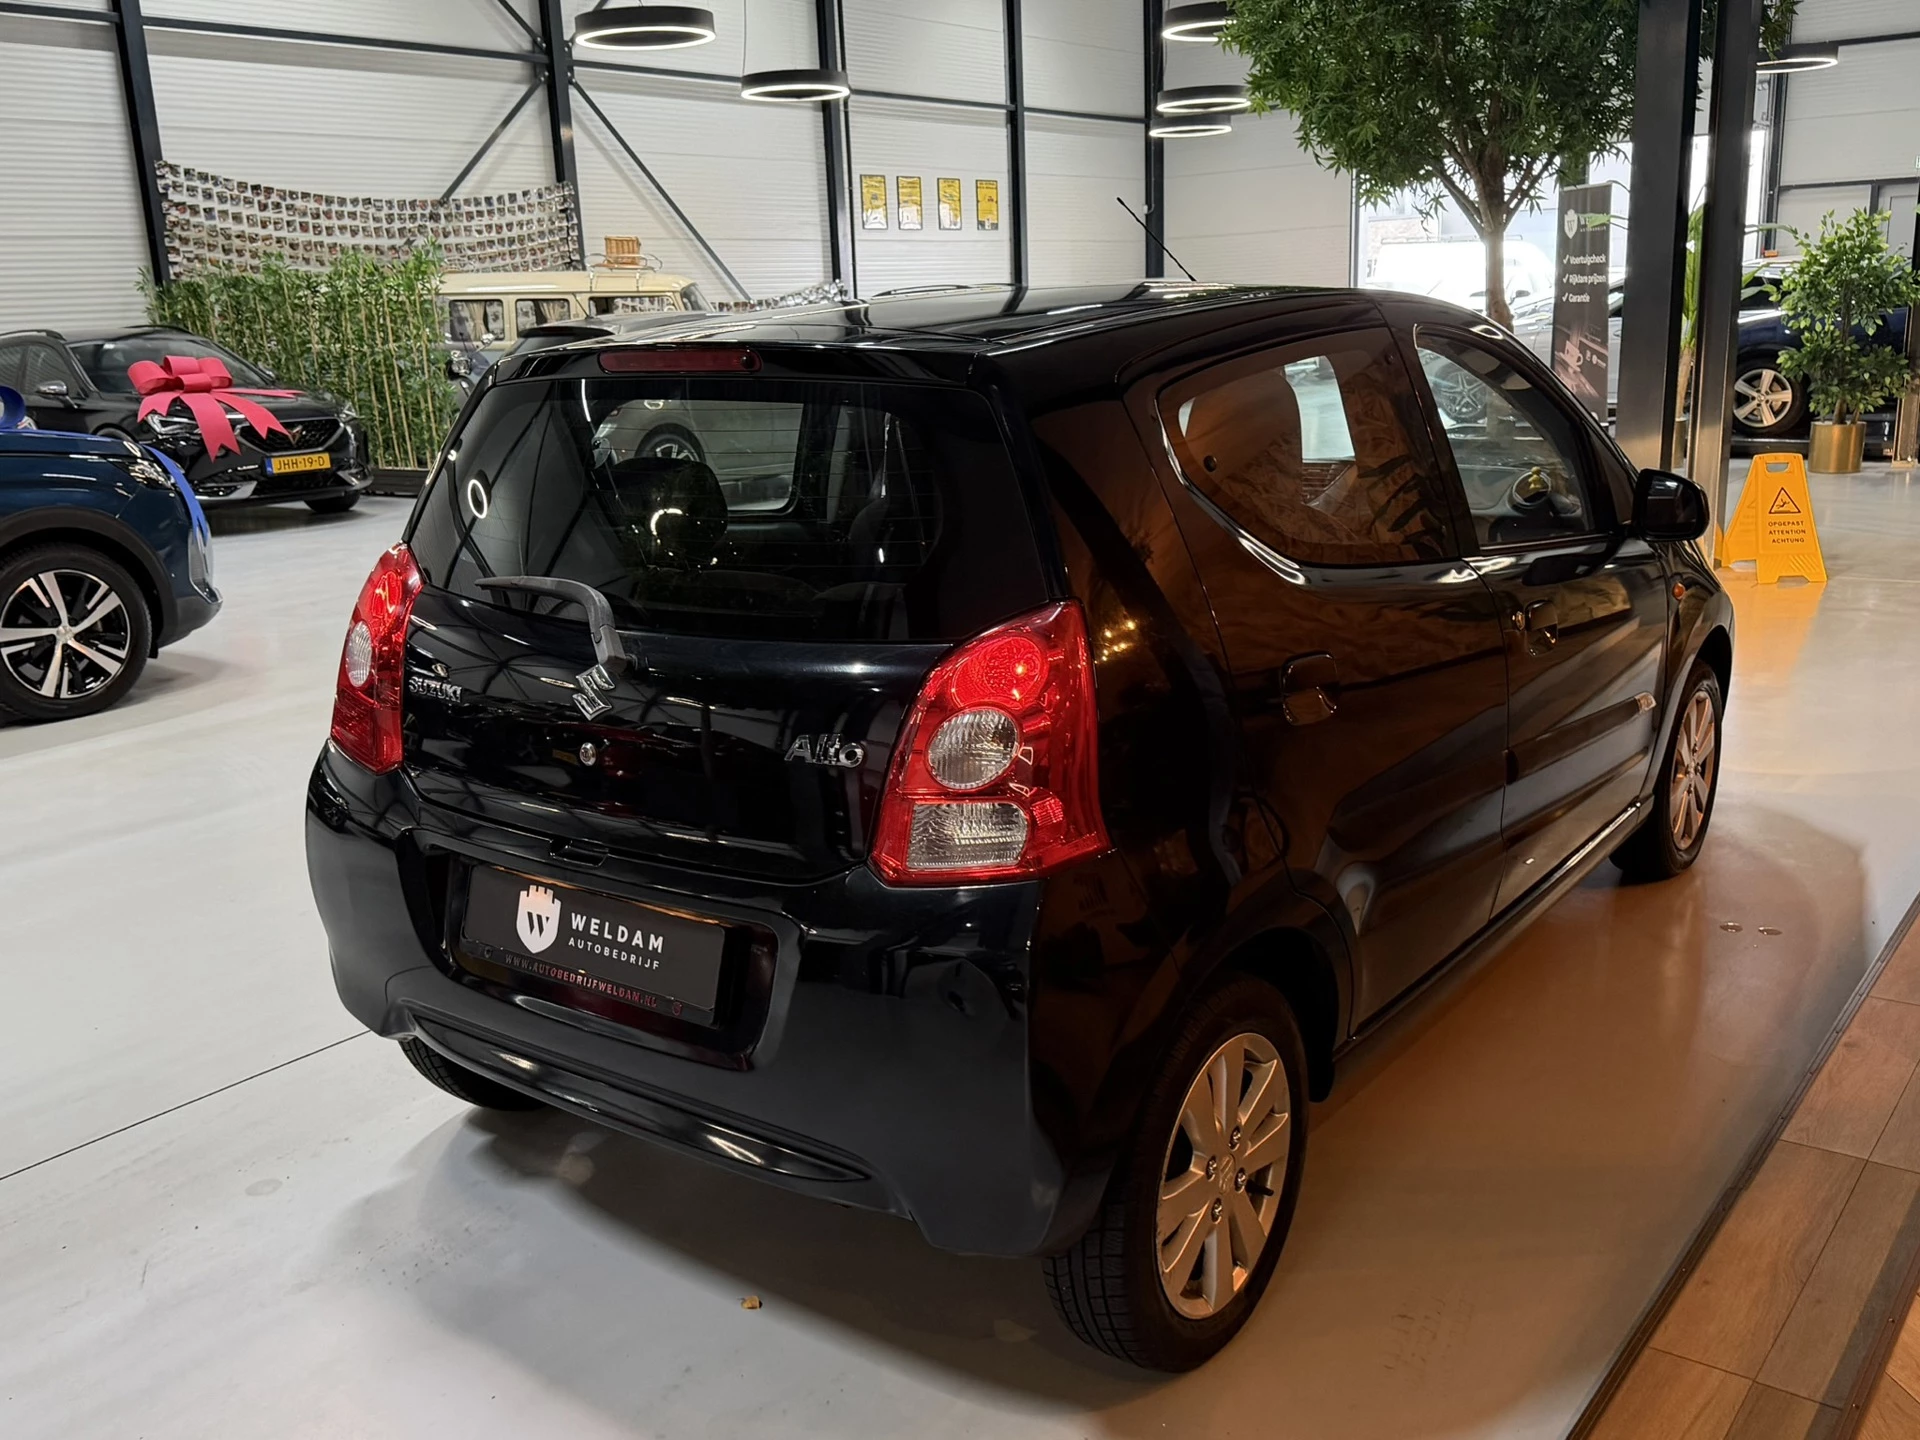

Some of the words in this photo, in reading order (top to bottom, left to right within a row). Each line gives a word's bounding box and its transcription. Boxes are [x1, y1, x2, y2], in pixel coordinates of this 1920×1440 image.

[408, 675, 463, 703] SUZUKI
[784, 733, 864, 768] Alto
[571, 911, 664, 954] WELDAM
[568, 936, 660, 971] AUTOBEDRIJF
[504, 953, 657, 1009] WWW.AUTOBEDRIJFWELDAM.NL
